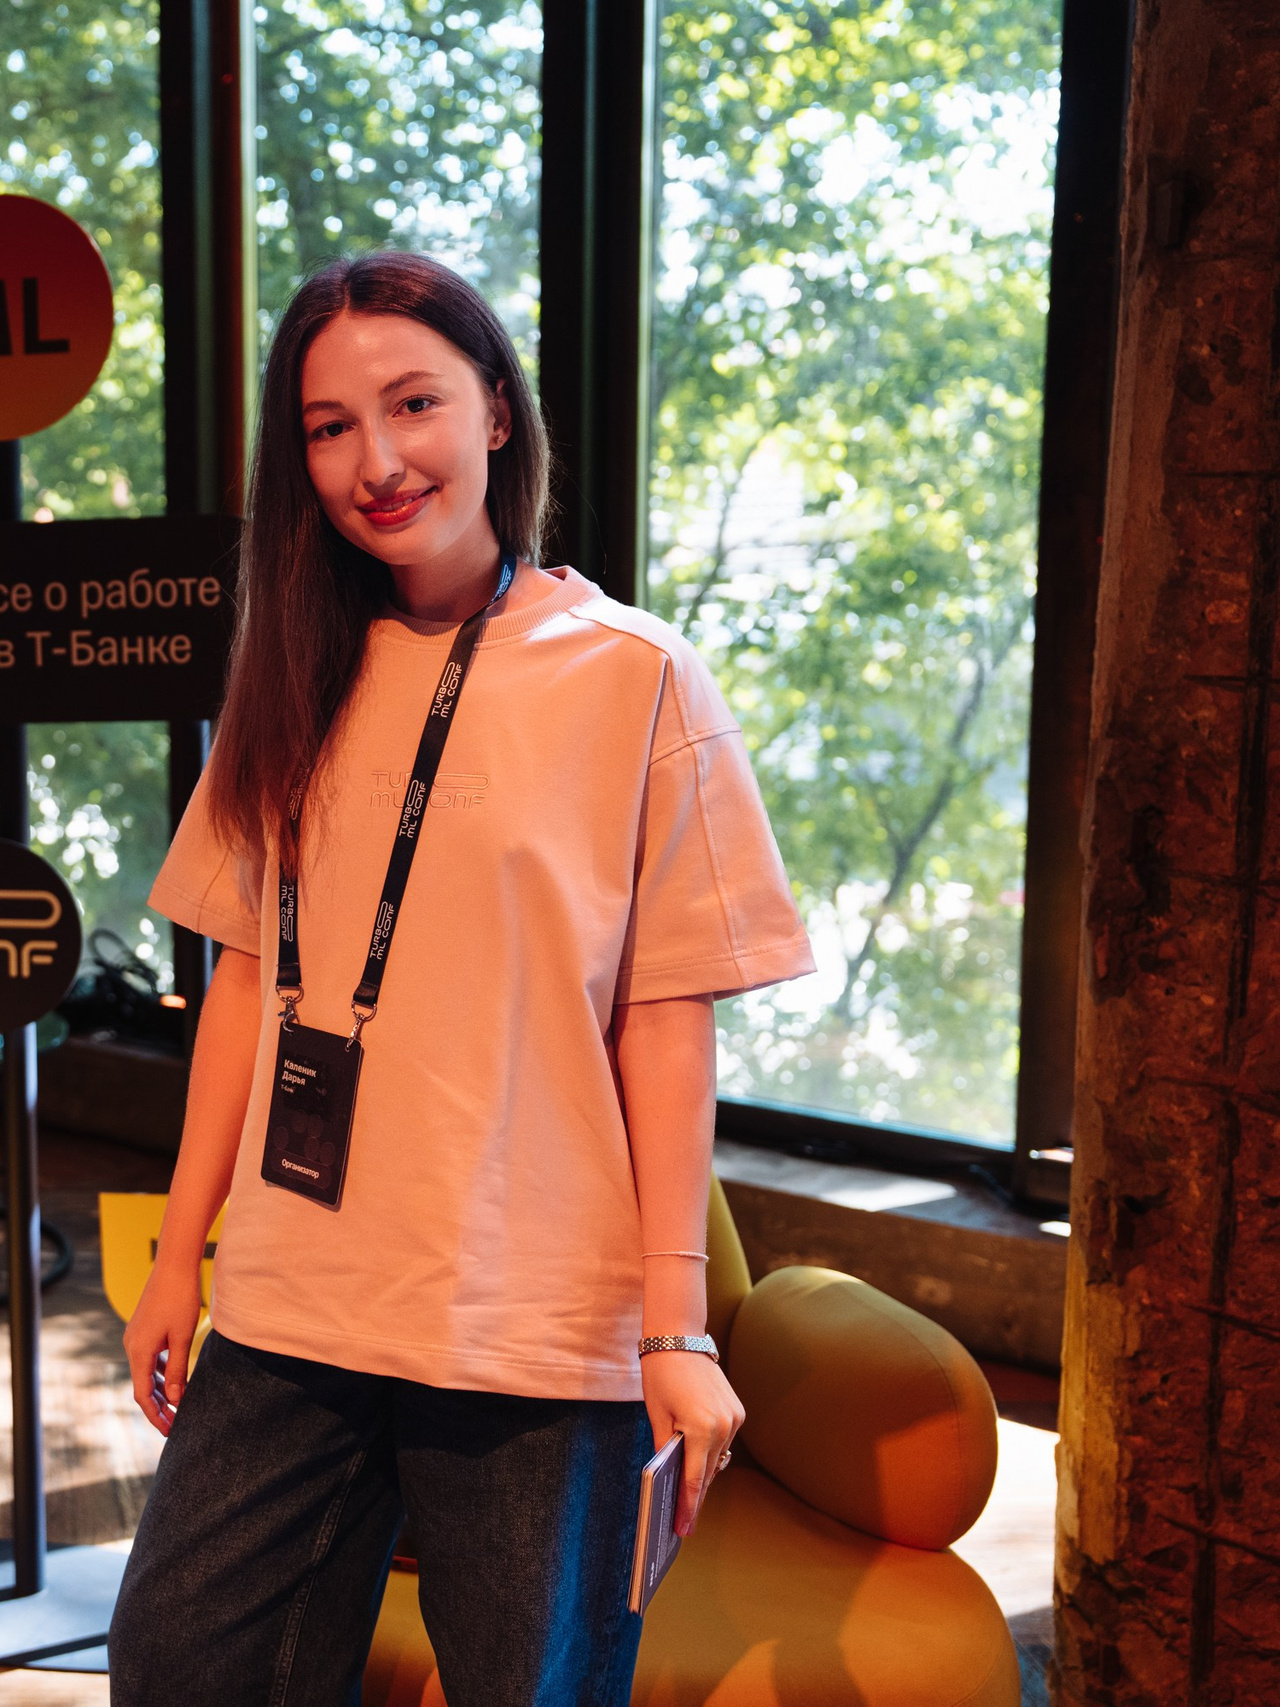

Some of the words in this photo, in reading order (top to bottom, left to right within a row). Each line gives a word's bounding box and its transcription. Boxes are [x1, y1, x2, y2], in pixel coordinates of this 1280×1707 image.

[43, 581, 68, 611] о
[80, 568, 220, 618] работе
[26, 630, 192, 667] Т-Банке
[431, 661, 455, 716] TURBO
[440, 700, 452, 718] ML
[447, 663, 463, 697] CONF
[398, 779, 419, 836] TURBO
[406, 820, 418, 839] ML
[412, 781, 426, 816] CONF
[429, 792, 486, 809] ONF
[281, 885, 287, 903] ML
[286, 885, 294, 942] TURBO
[369, 901, 388, 958] TURBO
[376, 942, 386, 960] ML
[381, 903, 395, 938] CONF
[281, 1070, 306, 1086] Дарья
[283, 1059, 317, 1078] Каленик
[281, 1158, 320, 1179] Организатор
